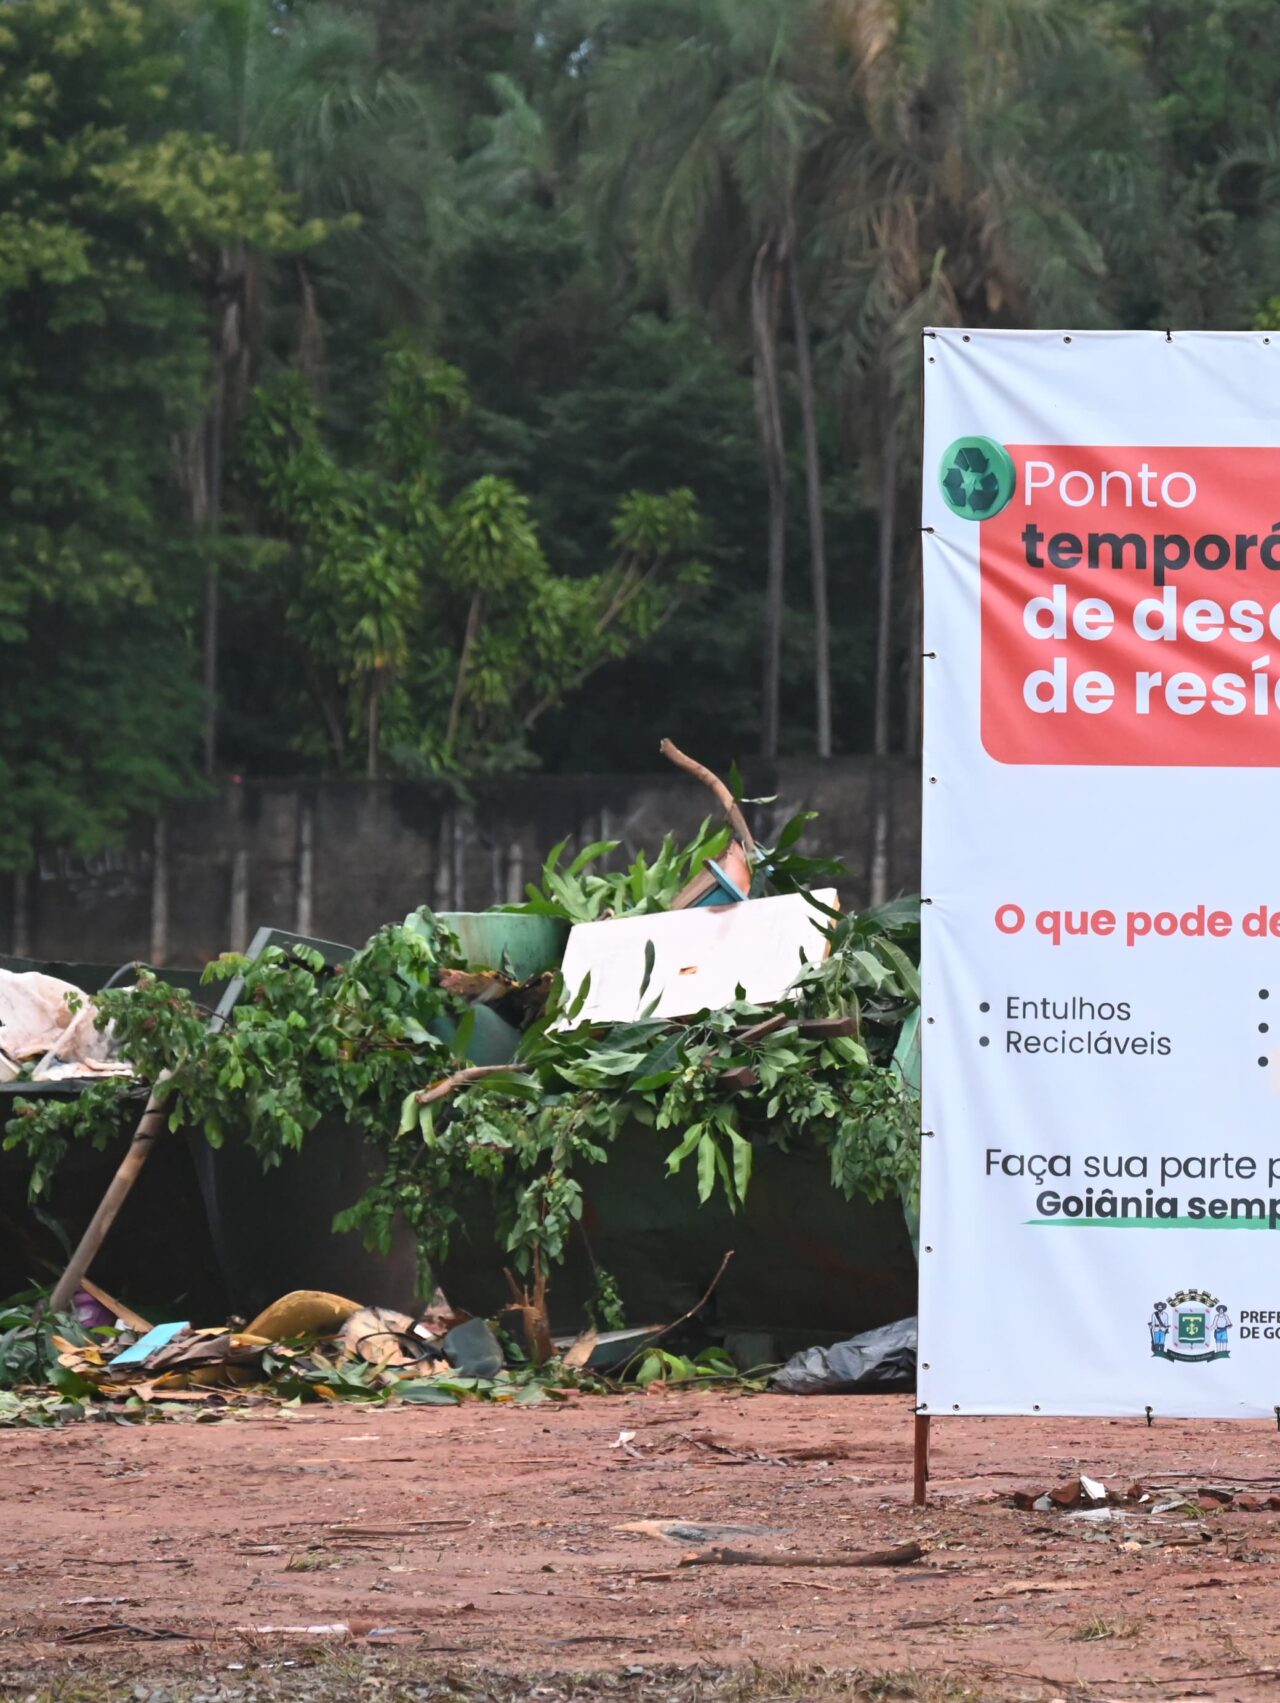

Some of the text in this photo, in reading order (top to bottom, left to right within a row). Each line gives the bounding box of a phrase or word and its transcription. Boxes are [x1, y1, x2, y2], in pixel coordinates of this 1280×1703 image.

[1025, 461, 1196, 508] Ponto
[1023, 585, 1114, 640] de
[1023, 657, 1115, 714] de
[995, 904, 1025, 934] O
[1036, 910, 1116, 945] que
[1127, 905, 1232, 947] pode
[1007, 997, 1130, 1020] Entulhos
[1007, 1031, 1171, 1055] Recicláveis
[987, 1149, 1070, 1185] Faça
[1085, 1156, 1147, 1177] sua
[1161, 1153, 1256, 1186] parte
[1037, 1188, 1177, 1218] Goiânia
[1240, 1327, 1259, 1338] DE
